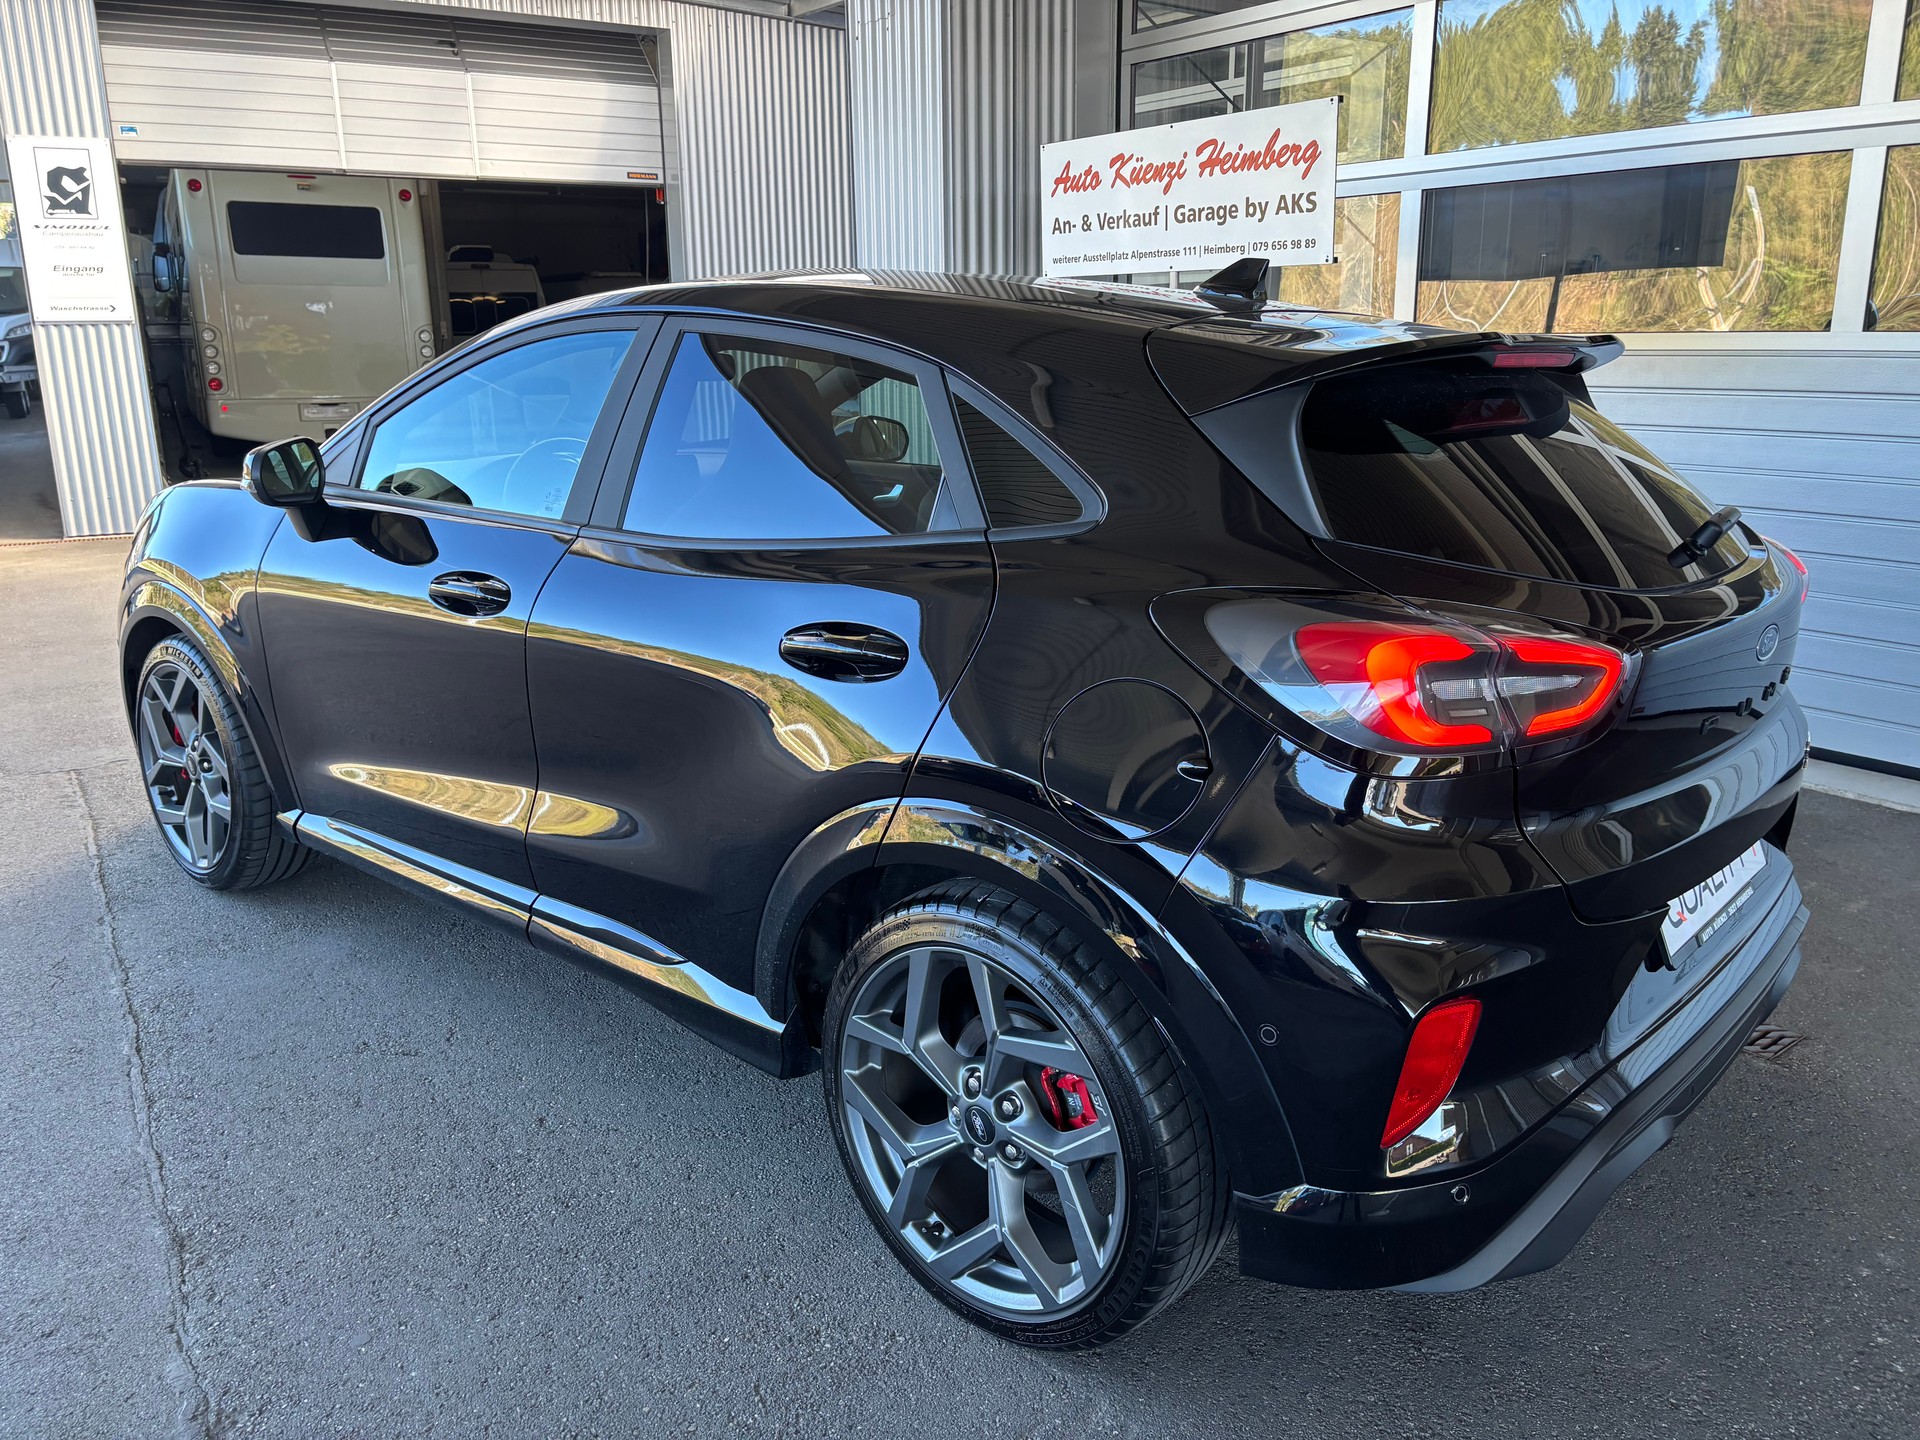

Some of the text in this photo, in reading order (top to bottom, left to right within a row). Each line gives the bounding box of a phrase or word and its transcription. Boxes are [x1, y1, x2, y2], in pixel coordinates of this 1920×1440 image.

[1051, 127, 1322, 198] Auto Küenzi Heimberg
[1052, 217, 1077, 235] An-
[1081, 214, 1093, 232] &
[1097, 206, 1161, 231] Verkauf
[1173, 203, 1239, 226] Garage
[1245, 196, 1270, 223] by
[1275, 191, 1318, 216] AKS
[53, 265, 104, 274] Eingang
[1052, 255, 1081, 264] weiterer
[1083, 251, 1129, 263] Ausstellplatz
[1131, 248, 1180, 261] Alpenstrasse
[1183, 246, 1197, 256] 111
[1203, 243, 1246, 255] Heimberg
[1252, 241, 1269, 251] 079
[1271, 239, 1288, 250] 656
[1290, 239, 1302, 249] 98
[1304, 238, 1316, 248] 89
[168, 647, 201, 677] MICHELIN
[1103, 1215, 1154, 1319] MICHELIN
